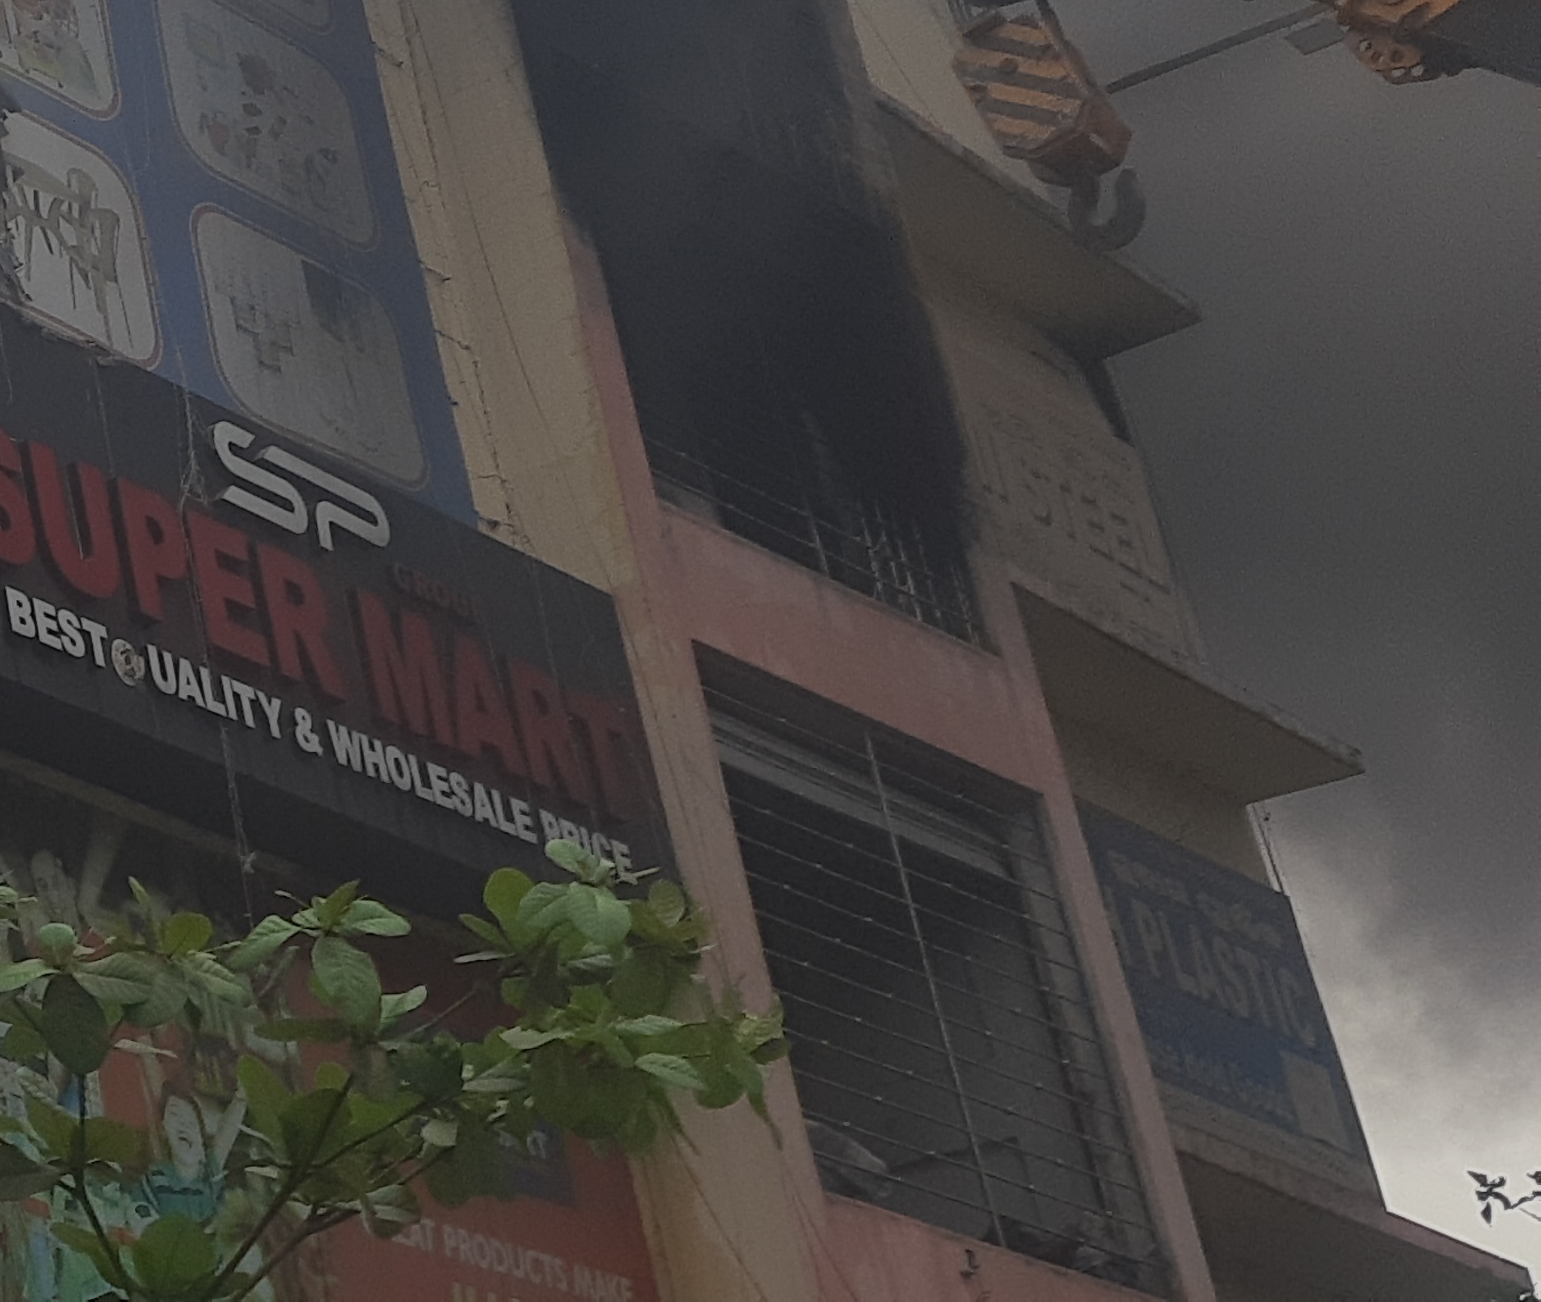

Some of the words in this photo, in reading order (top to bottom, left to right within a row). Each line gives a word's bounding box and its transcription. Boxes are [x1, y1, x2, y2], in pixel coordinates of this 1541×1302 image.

[214, 420, 392, 550] SP
[5, 585, 108, 669] BEST
[293, 706, 324, 756] &
[326, 718, 538, 845] WHOLESALE
[356, 585, 631, 822] MART
[1130, 896, 1317, 1048] PLASTIC
[442, 1223, 569, 1293] PRODUCTS
